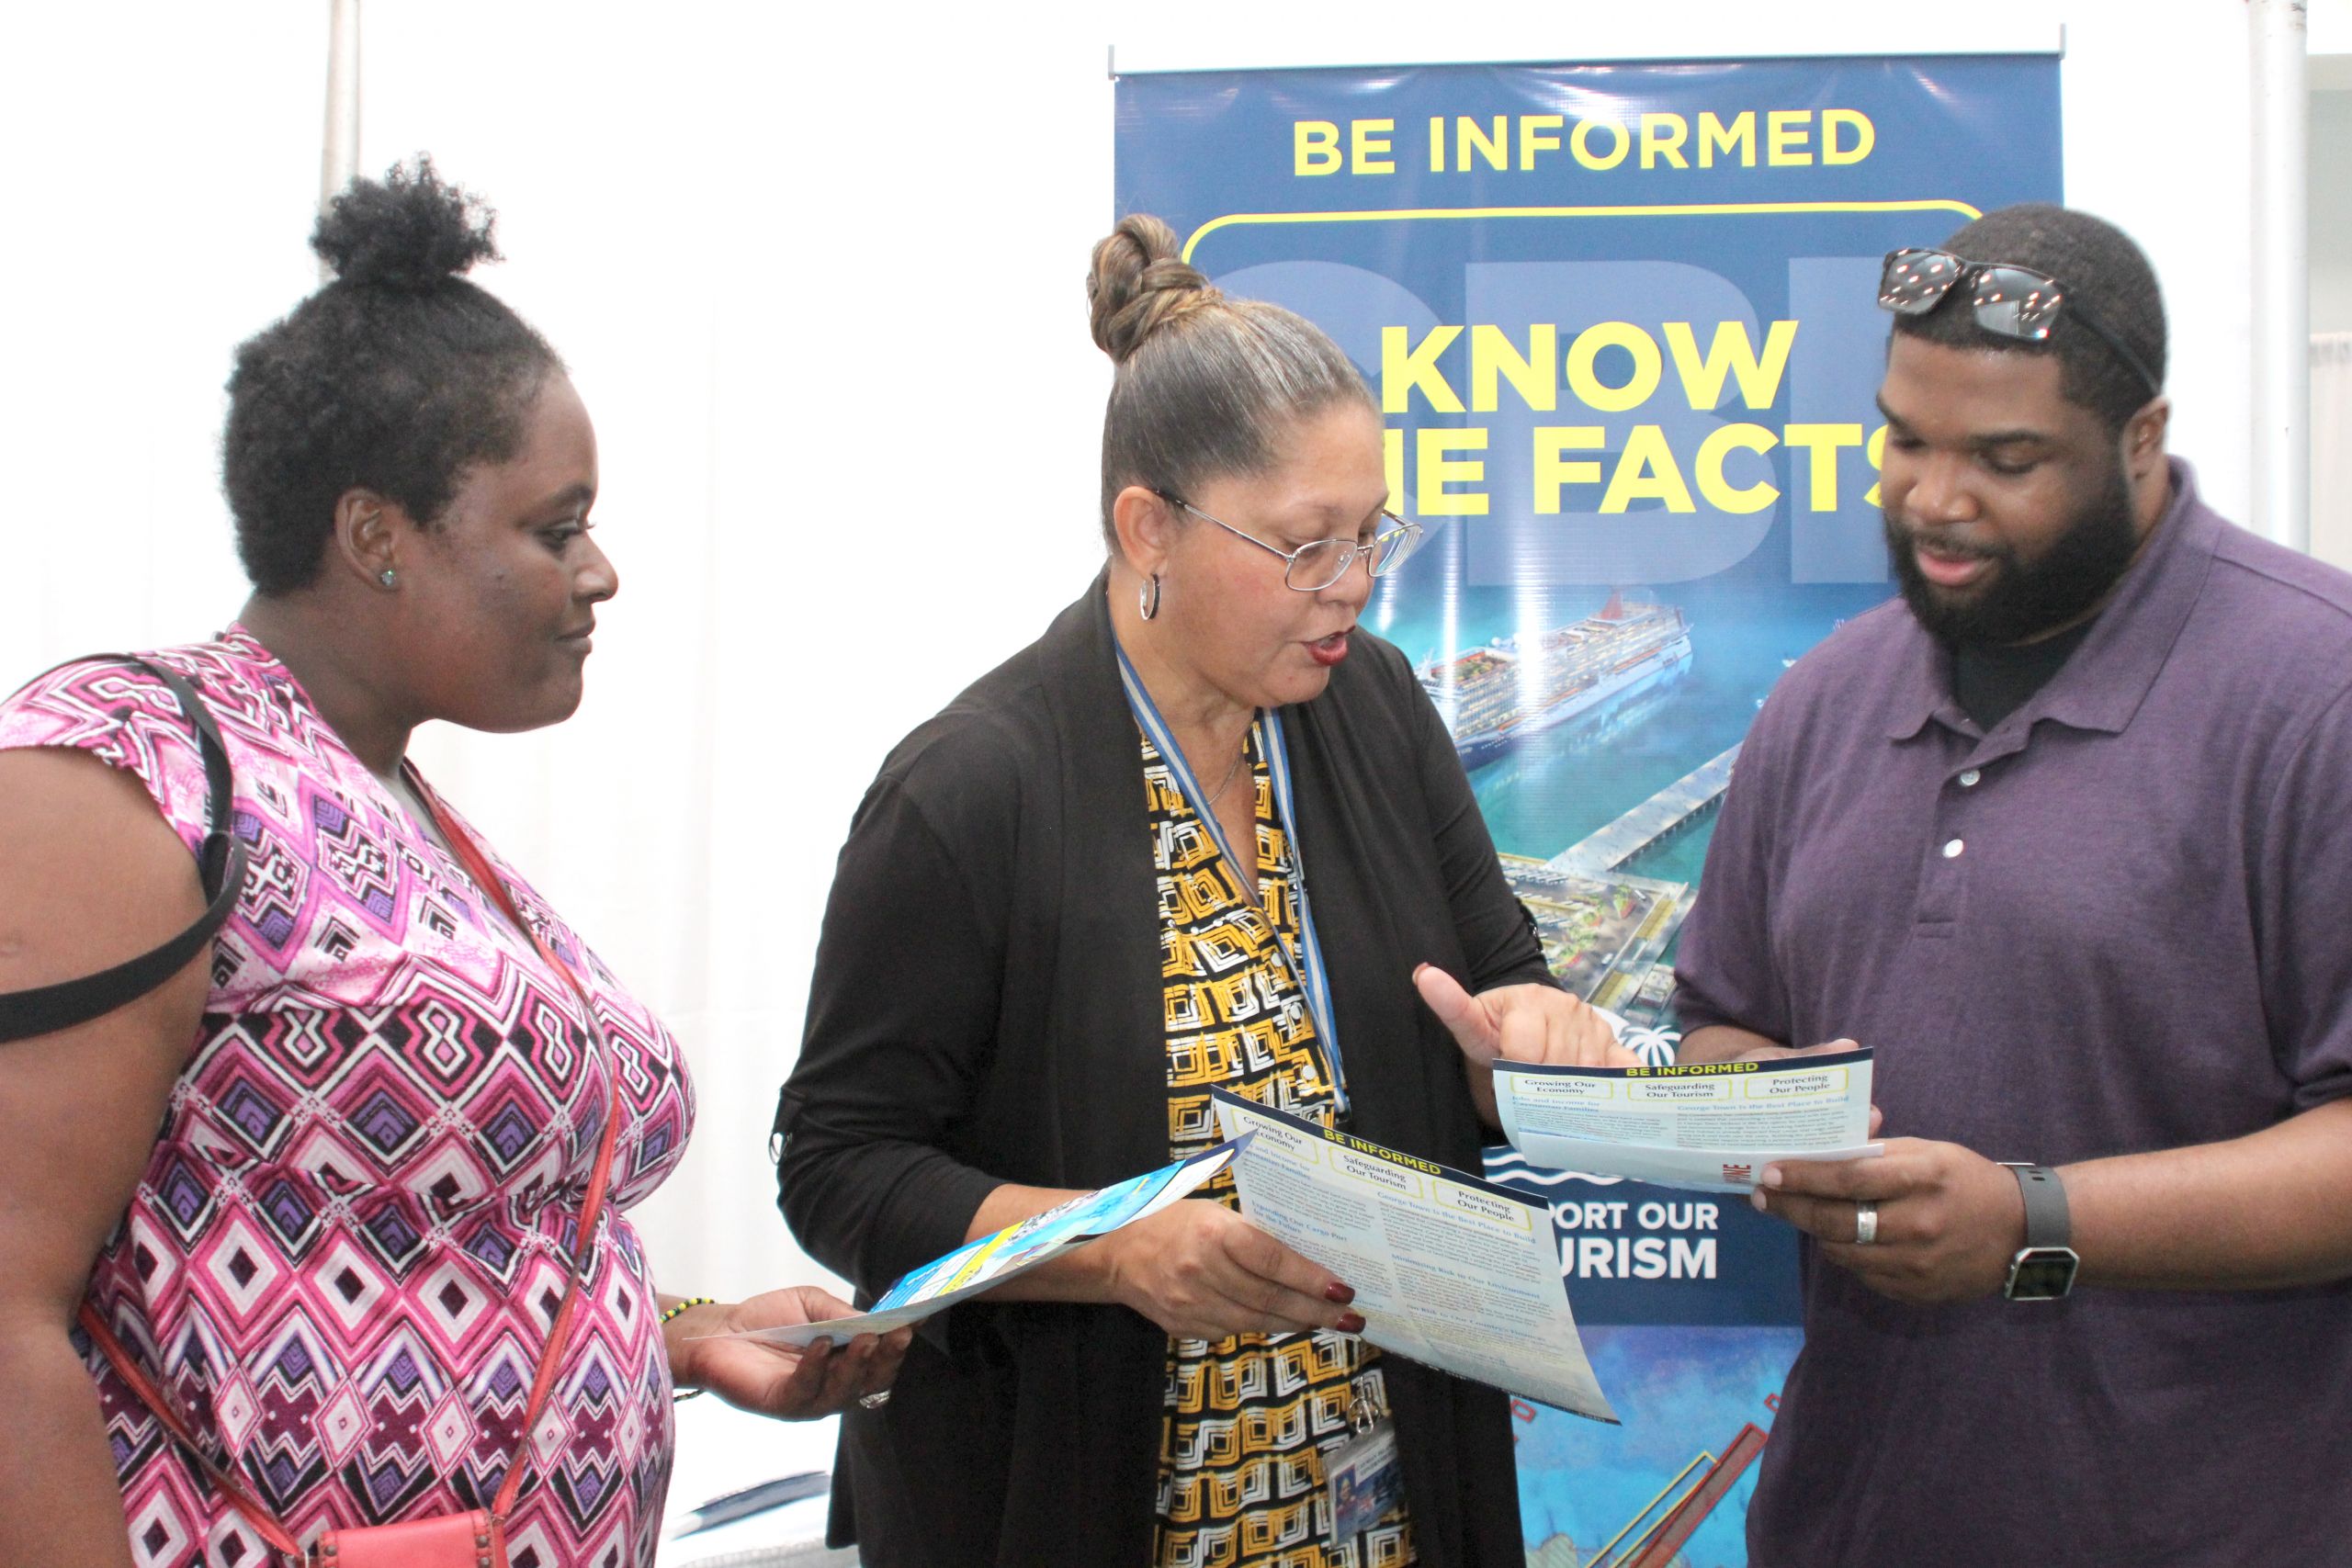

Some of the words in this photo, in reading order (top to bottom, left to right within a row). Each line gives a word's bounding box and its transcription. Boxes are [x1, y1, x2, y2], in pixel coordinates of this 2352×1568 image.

[1295, 119, 1395, 175] BE
[1430, 109, 1874, 172] INFORMED
[1382, 320, 1798, 413] KNOW
[1626, 1067, 1651, 1077] BE
[1657, 1062, 1758, 1077] INFORMED
[1772, 1074, 1829, 1086] Protecting
[1524, 1078, 1572, 1089] Growing
[1536, 1087, 1586, 1095] Economy
[1645, 1083, 1715, 1091] Safeguarding
[1793, 1082, 1831, 1094] People
[1243, 1116, 1283, 1138] Growing
[1285, 1133, 1303, 1145] Our
[1255, 1131, 1296, 1152] conomy
[1323, 1129, 1346, 1145] BE
[1351, 1138, 1442, 1175] INFORMED
[1343, 1155, 1407, 1183] Safeguarding
[1346, 1165, 1366, 1177] Our
[1370, 1171, 1408, 1190] Tourism
[1457, 1199, 1478, 1212] Our
[1481, 1203, 1515, 1222] People
[1458, 1190, 1510, 1213] Protecting
[1637, 1202, 1719, 1230] OUR
